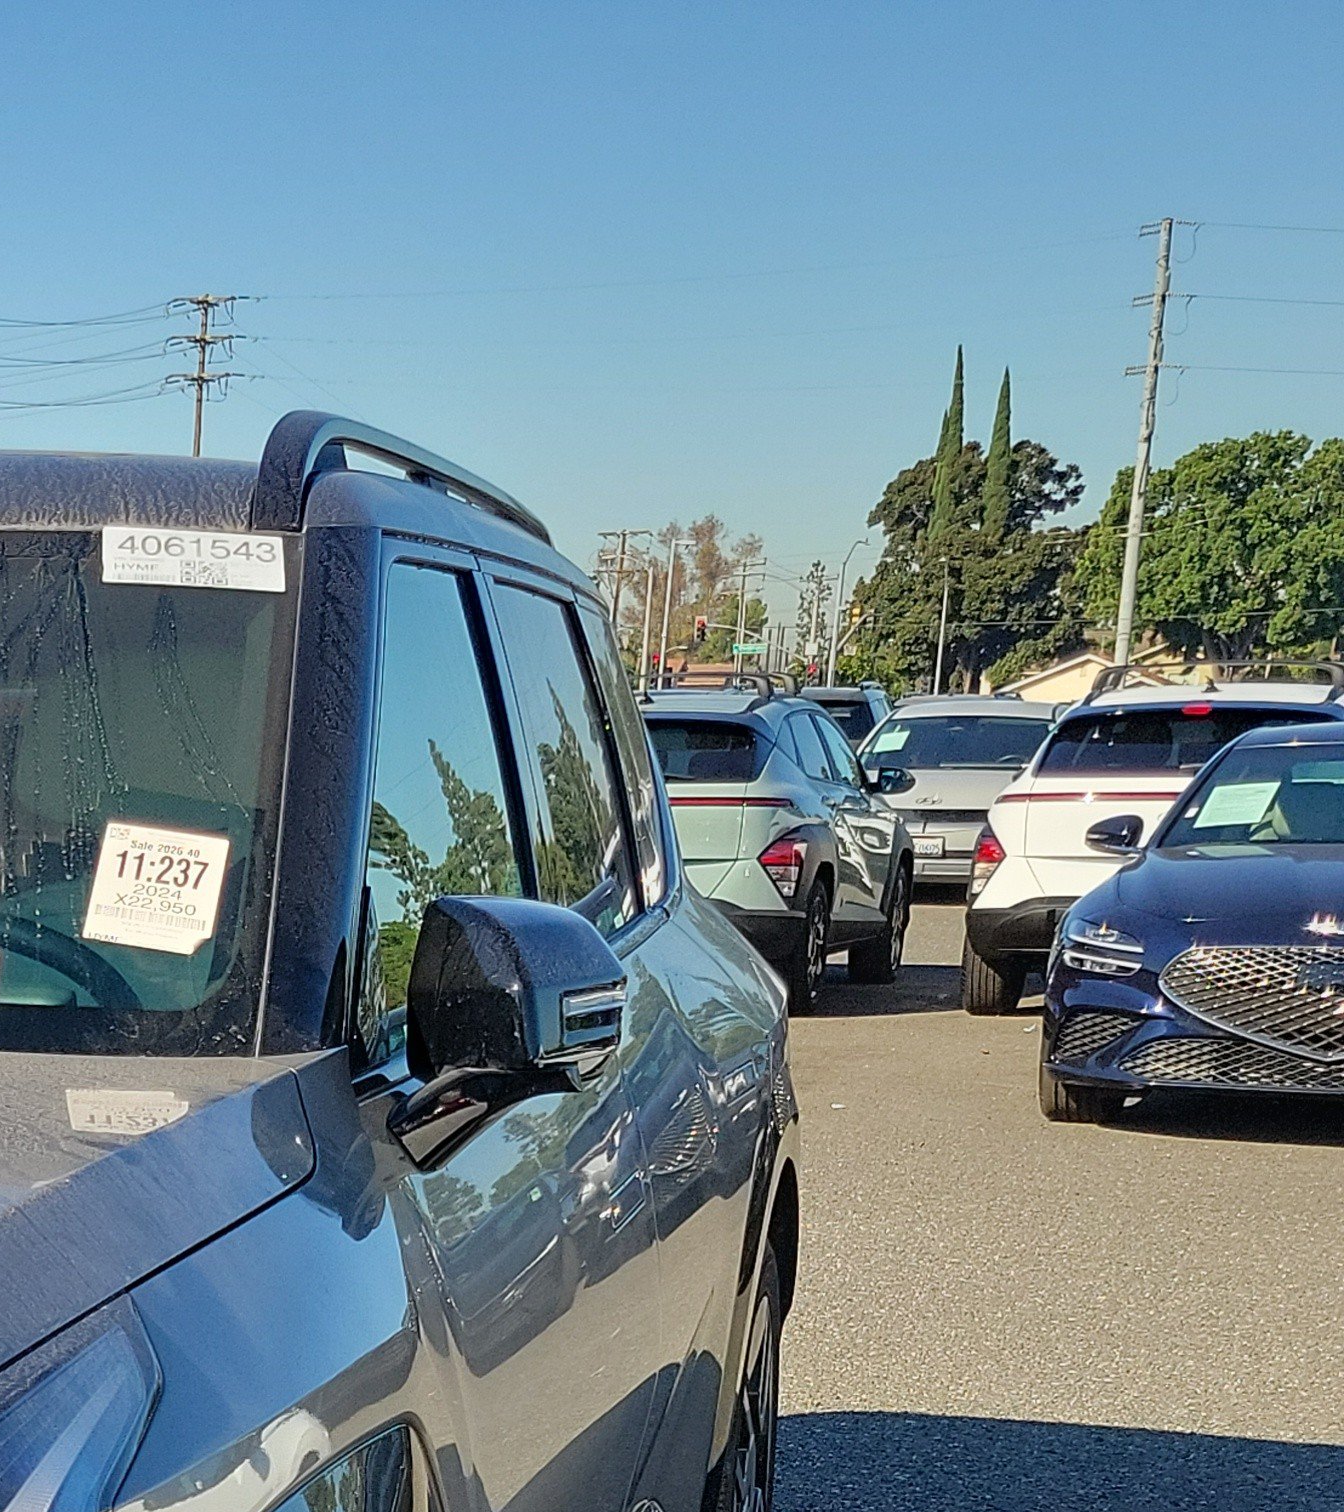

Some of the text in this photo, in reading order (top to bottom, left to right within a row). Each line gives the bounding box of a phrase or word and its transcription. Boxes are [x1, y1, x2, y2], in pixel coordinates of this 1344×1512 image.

[117, 534, 277, 563] 4061543
[130, 840, 154, 852] Sale
[116, 850, 210, 890] 11:237
[132, 883, 183, 901] 2024
[114, 893, 197, 916] X22,950
